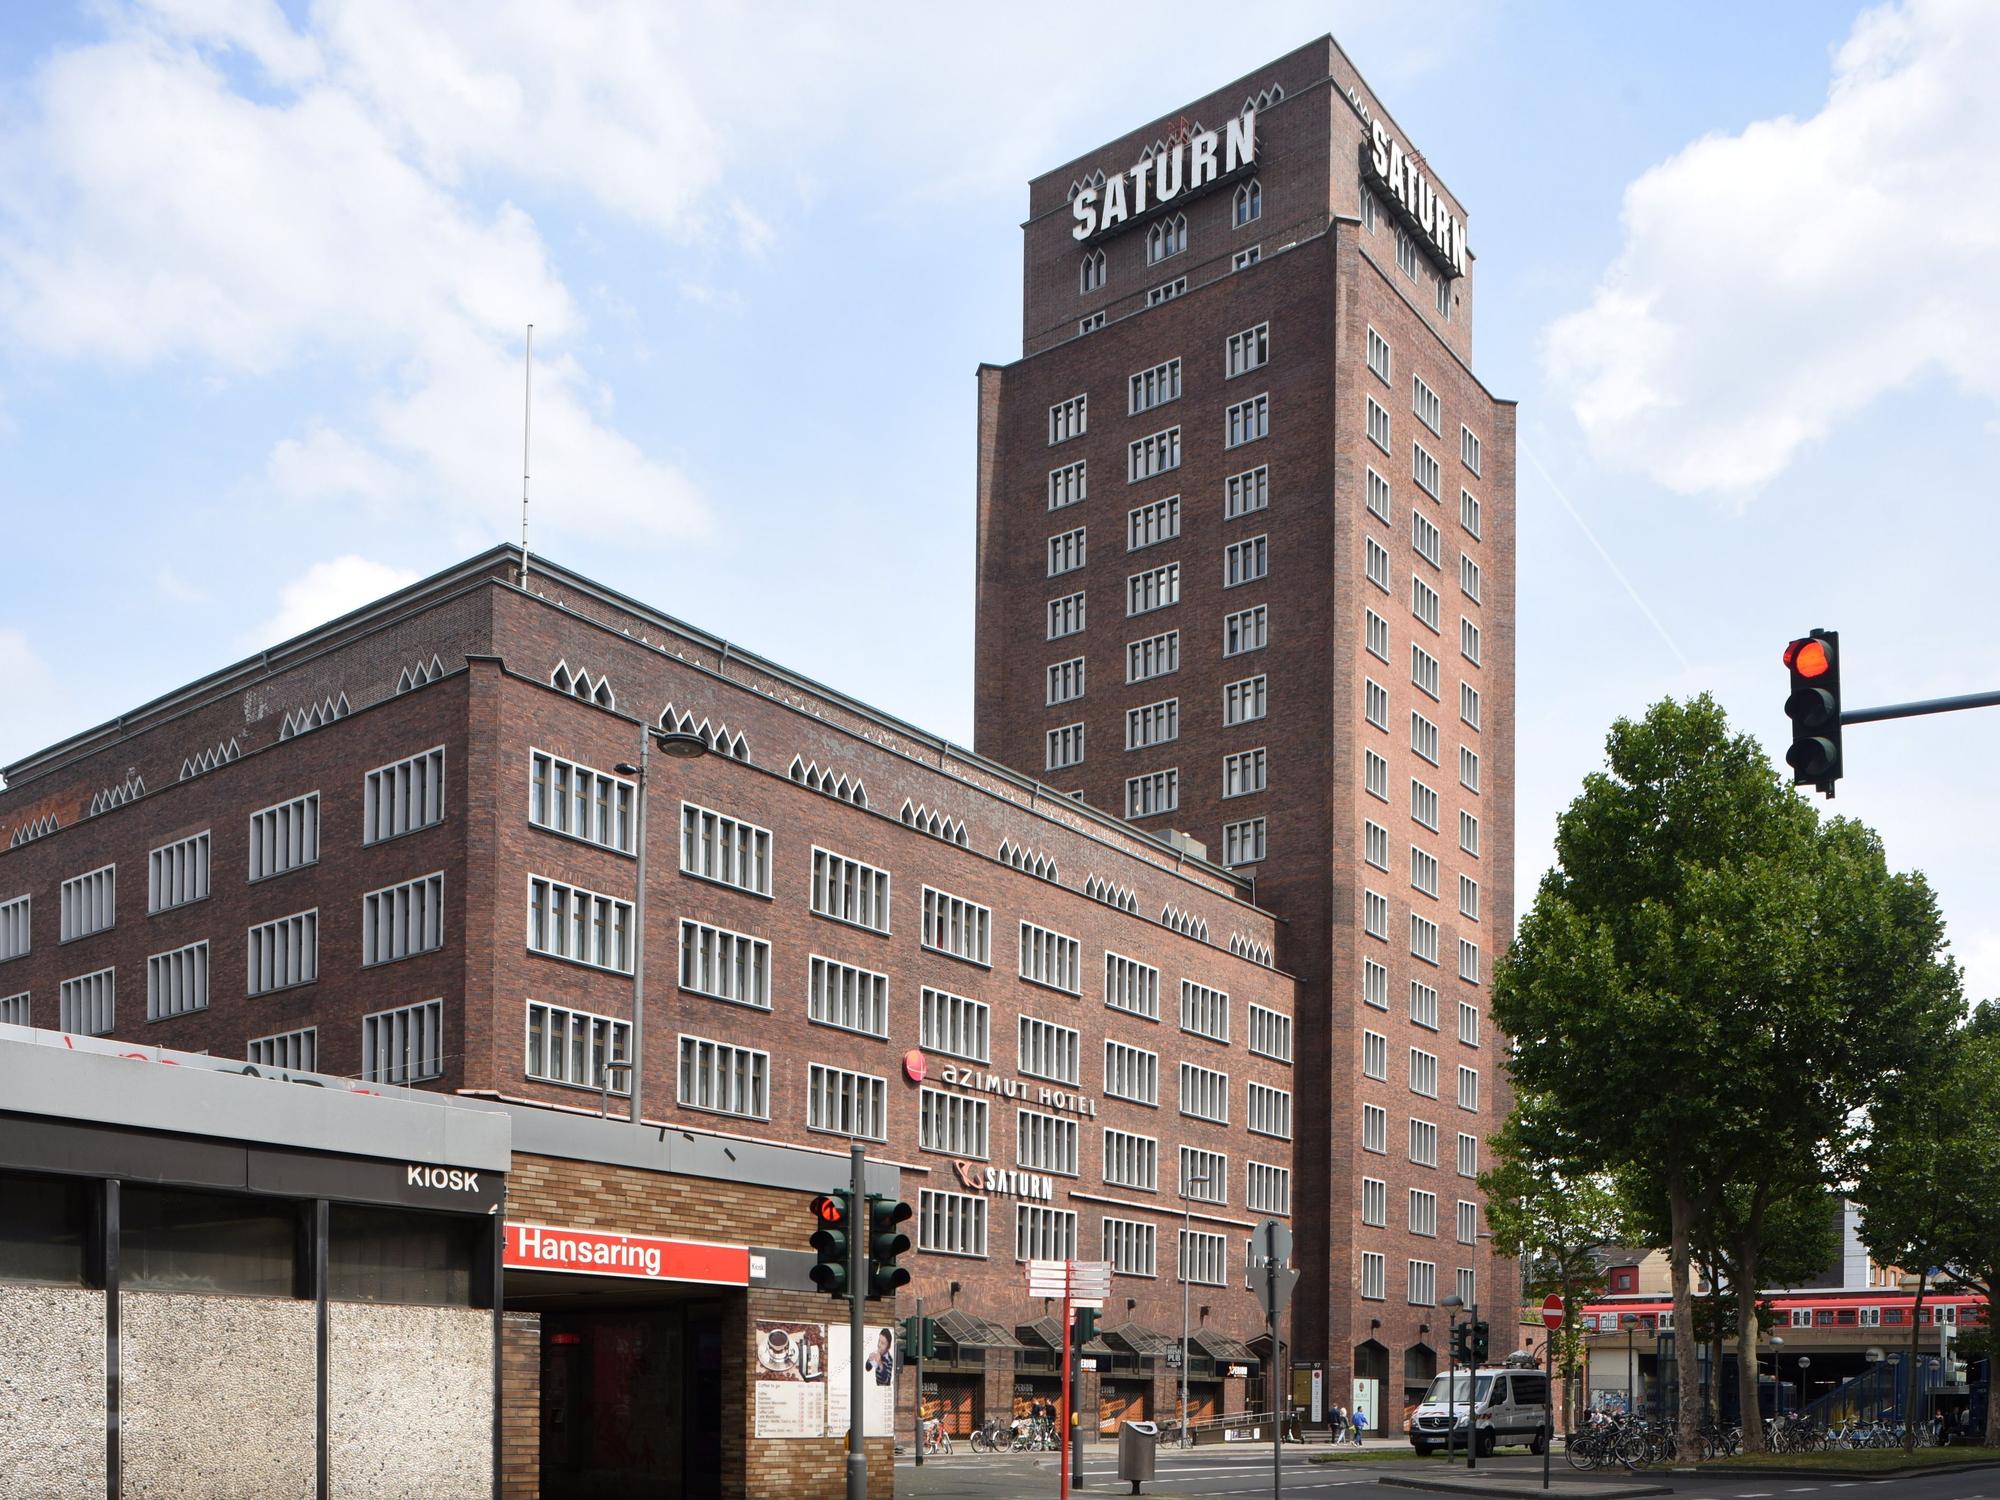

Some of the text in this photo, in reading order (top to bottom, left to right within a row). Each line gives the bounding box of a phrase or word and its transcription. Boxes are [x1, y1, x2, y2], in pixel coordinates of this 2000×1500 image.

[1072, 109, 1256, 241] SATURN
[1371, 118, 1466, 277] SATURN
[1038, 1087, 1097, 1116] HOTEL
[407, 1165, 480, 1193] KIOSK
[984, 1166, 1053, 1200] SATURN
[518, 1228, 661, 1276] Hansaring
